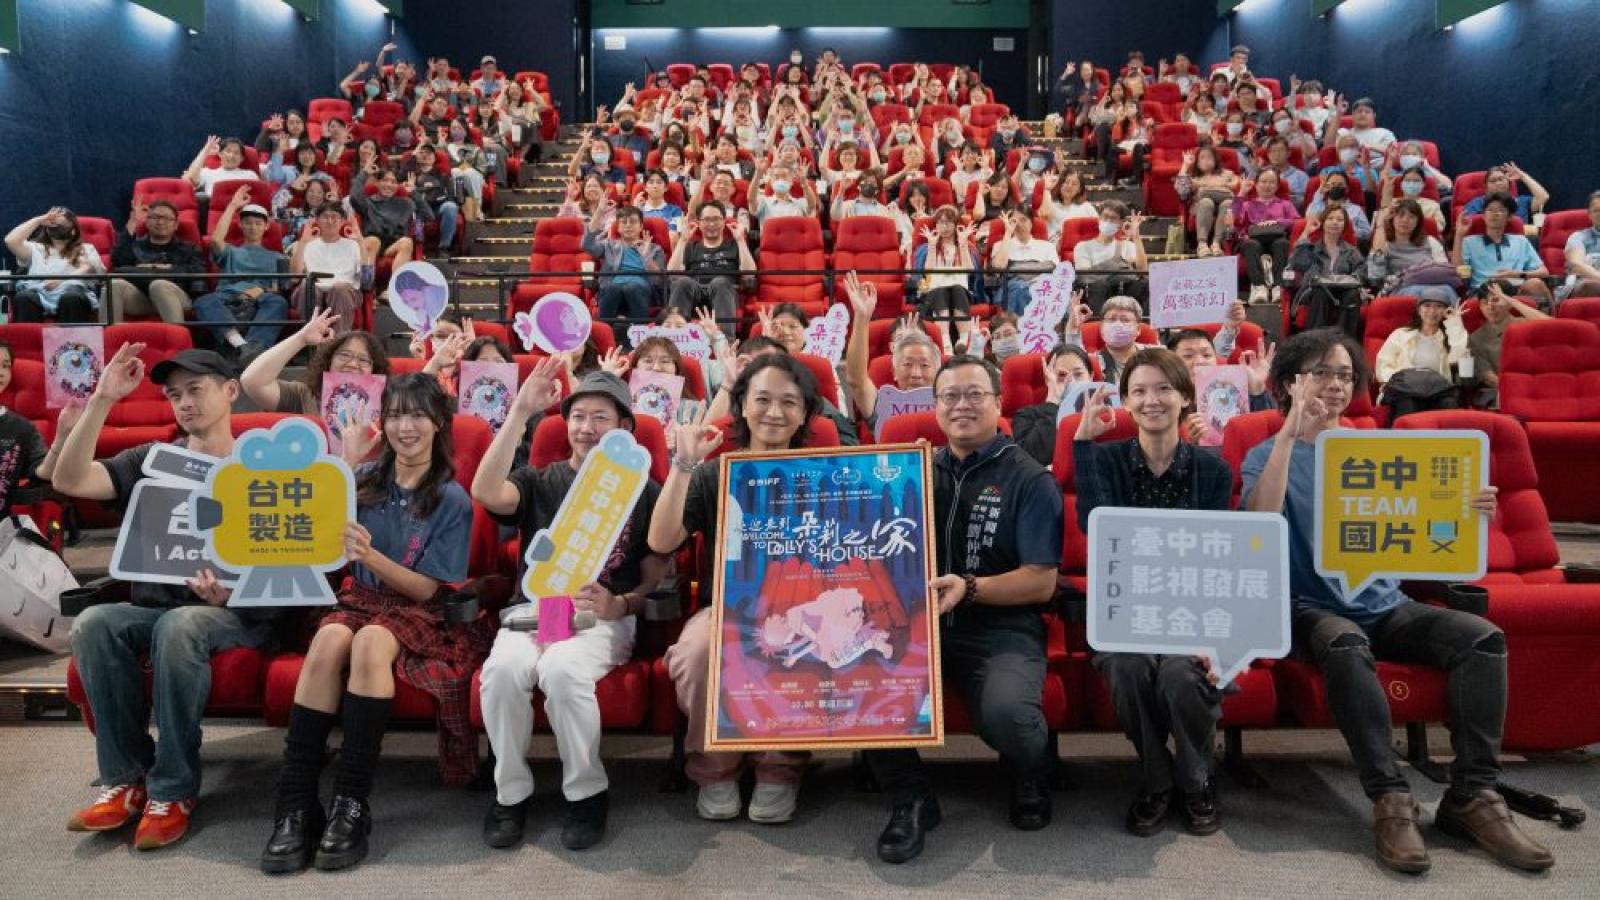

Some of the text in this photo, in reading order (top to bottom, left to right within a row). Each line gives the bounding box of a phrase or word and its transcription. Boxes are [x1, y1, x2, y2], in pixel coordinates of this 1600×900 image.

[1341, 455, 1418, 490] 台中
[248, 478, 313, 507] 台中
[1338, 496, 1417, 515] TEAM
[248, 513, 314, 542] 製造
[792, 506, 917, 556] 朵莉之家
[1131, 527, 1232, 558] 臺中市
[1340, 521, 1416, 554] 國片
[814, 545, 884, 561] HOUSE
[1131, 564, 1268, 599] 影視發展
[1131, 605, 1232, 638] 基金會
